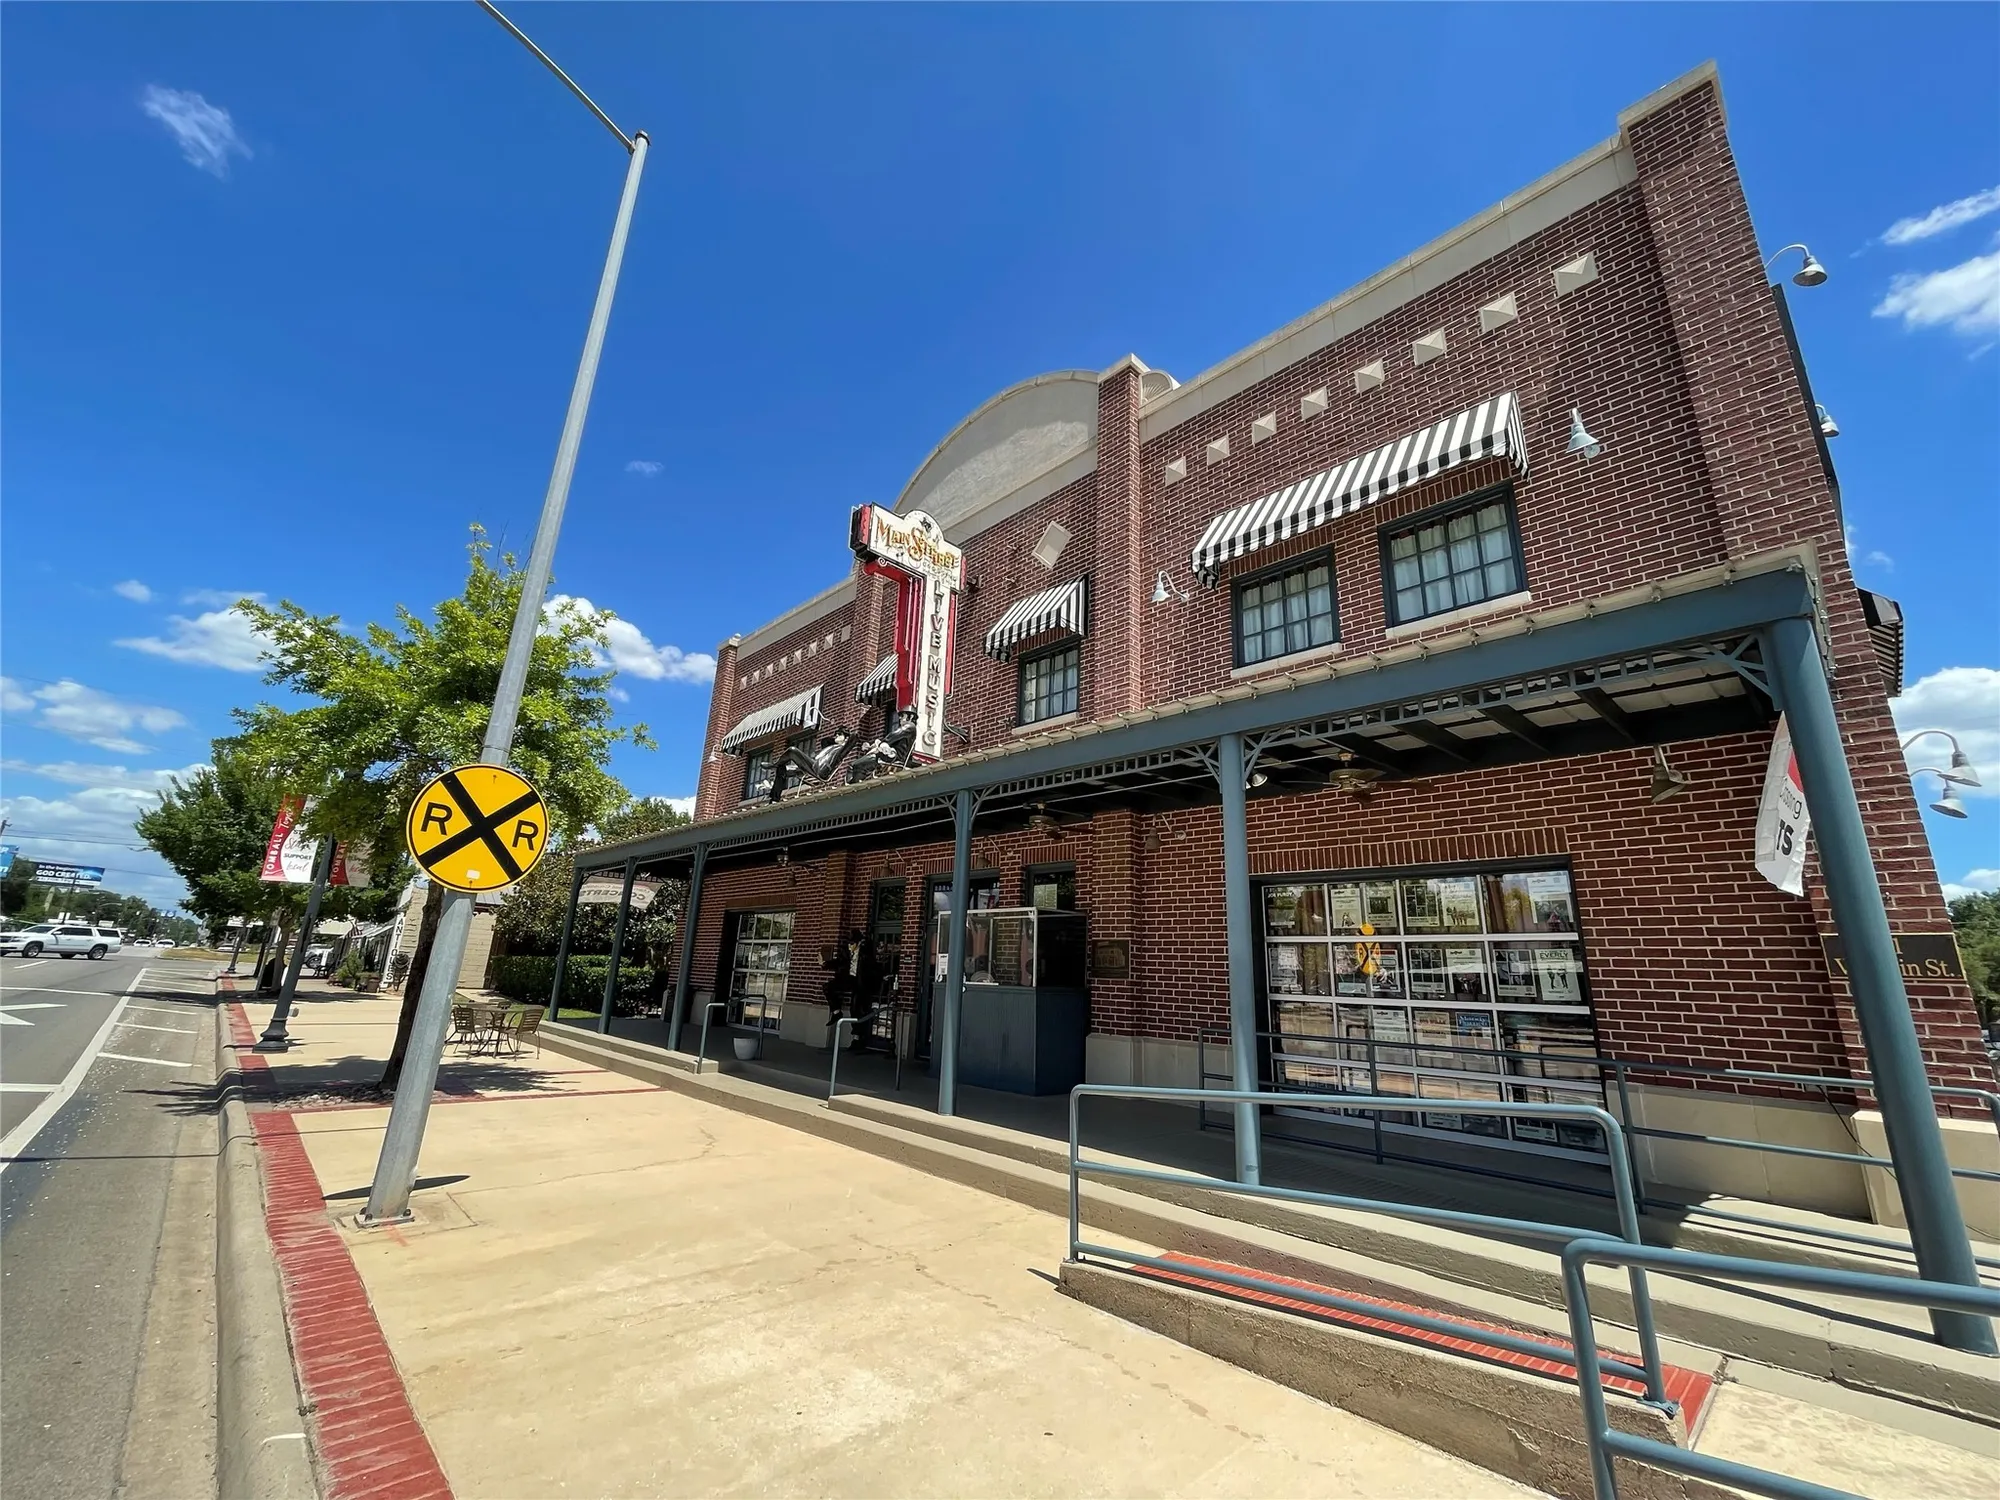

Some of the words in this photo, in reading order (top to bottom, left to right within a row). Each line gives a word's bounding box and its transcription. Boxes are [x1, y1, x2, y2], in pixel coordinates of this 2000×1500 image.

[930, 580, 944, 649] LIVE
[922, 654, 943, 746] MUSIC
[420, 801, 453, 836] R
[511, 819, 539, 851] R
[264, 832, 284, 875] TOMBALL
[284, 852, 313, 860] SUPPORT
[36, 869, 54, 877] GOD
[1925, 958, 1955, 977] St.
